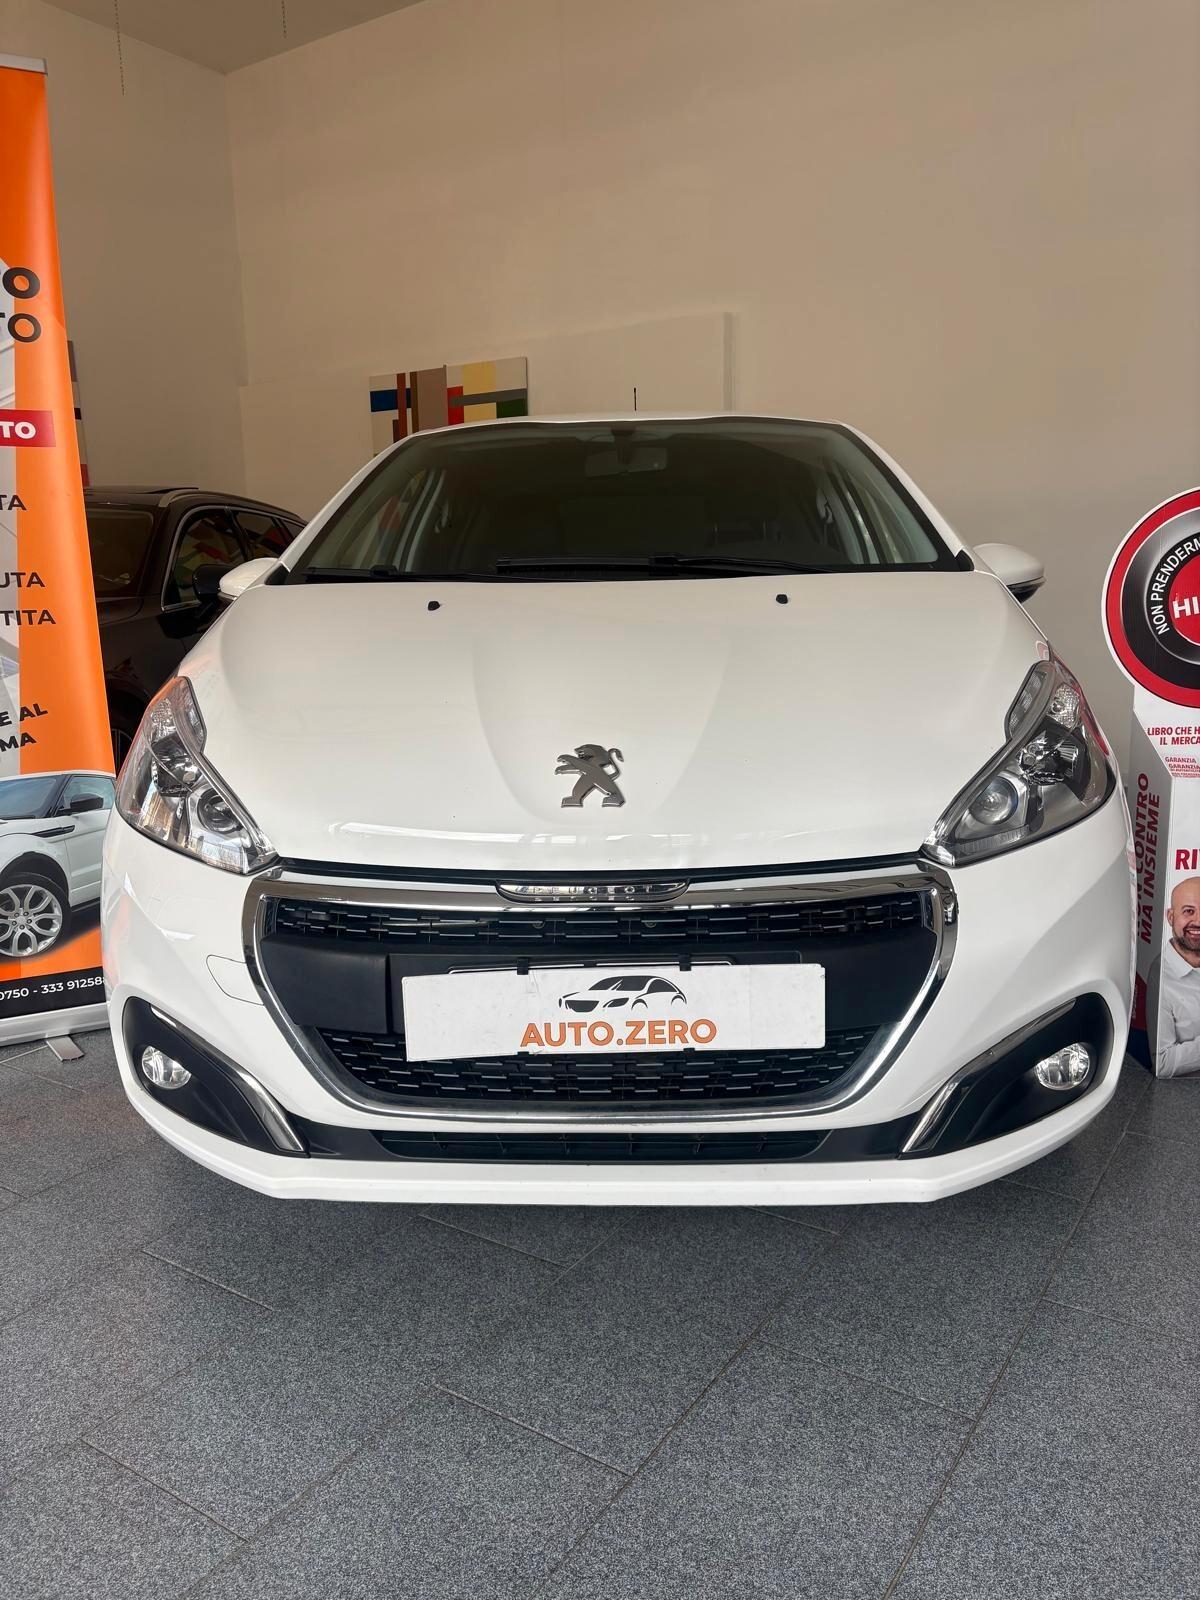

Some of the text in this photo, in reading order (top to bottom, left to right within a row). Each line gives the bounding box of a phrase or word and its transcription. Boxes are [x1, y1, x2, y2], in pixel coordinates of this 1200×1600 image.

[0, 267, 40, 299] O
[0, 312, 41, 342] O
[0, 421, 36, 439] TO
[0, 609, 56, 626] TITA
[1150, 604, 1170, 635] NON
[20, 703, 48, 721] AL
[1147, 727, 1173, 736] LIBRO
[1175, 727, 1192, 735] CHE
[1160, 737, 1168, 745] IL
[0, 732, 37, 752] MA
[1135, 773, 1149, 874] CONTRO
[1141, 792, 1160, 944] MA INSIEME
[1175, 849, 1200, 870] RI
[41, 982, 64, 994] 333
[67, 976, 105, 990] 91258
[520, 1018, 717, 1047] AUTO.ZERO
